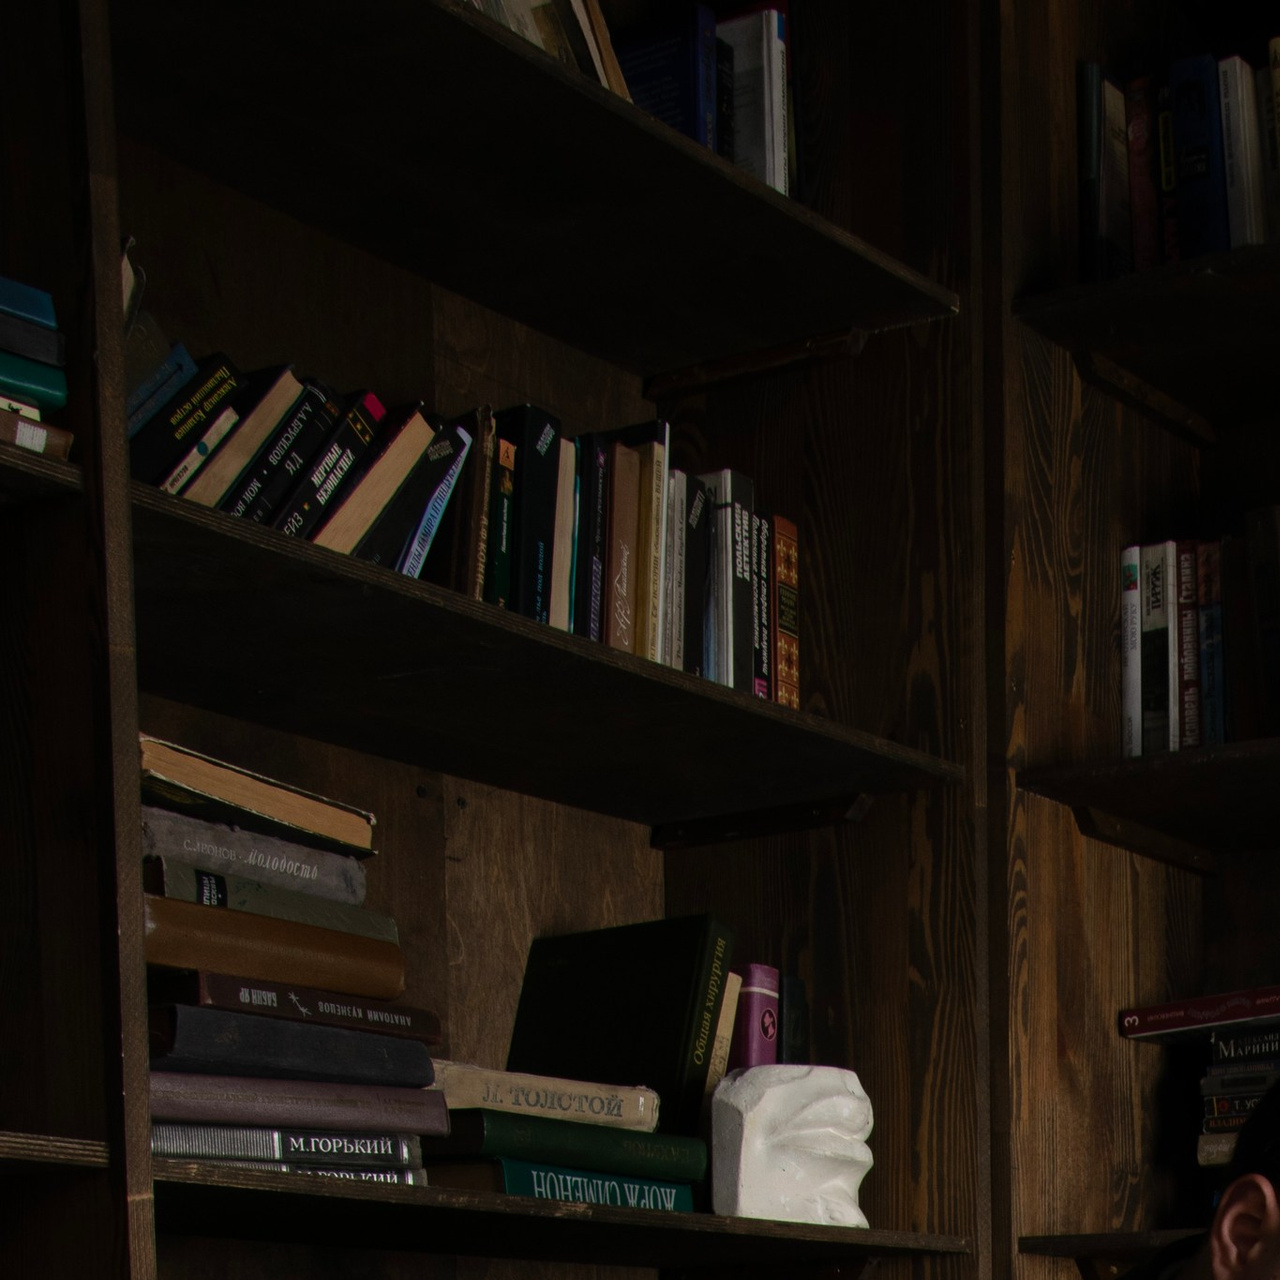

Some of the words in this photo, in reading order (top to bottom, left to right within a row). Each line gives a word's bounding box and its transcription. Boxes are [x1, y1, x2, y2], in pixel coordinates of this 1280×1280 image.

[200, 376, 238, 412] Александр
[239, 478, 263, 505] МОИ
[736, 509, 756, 581] ДЕТЕКТИВ
[404, 548, 425, 577] ЕНДЫ
[1178, 553, 1196, 602] Сталина
[700, 937, 731, 1010] хирургия
[237, 986, 251, 1003] ЯР
[248, 988, 279, 1008] БАБИЙ
[316, 999, 364, 1019] КУЗНЕЦОВ
[365, 1008, 412, 1027] АНАТОЛИЙ
[690, 1011, 715, 1065] Общая
[509, 1087, 624, 1119] ТОЛСТОЙ
[288, 1130, 393, 1157] М.ГОРЬКИЙ
[528, 1169, 623, 1208] СИМЕНОН
